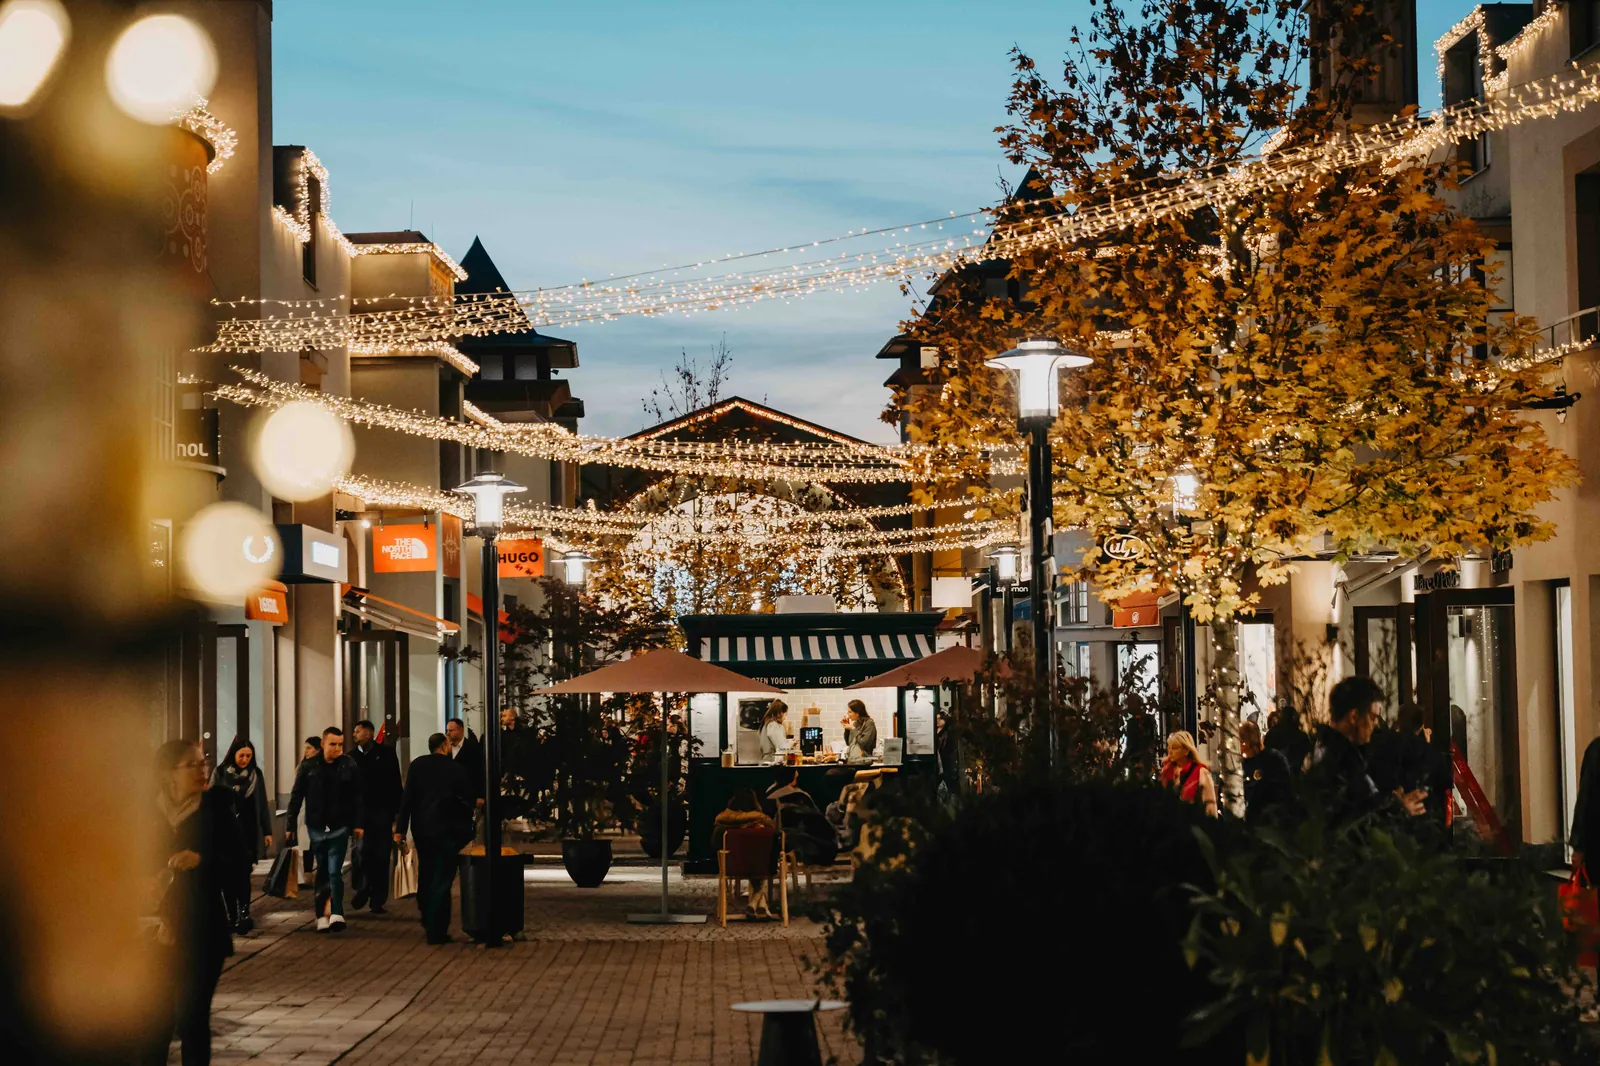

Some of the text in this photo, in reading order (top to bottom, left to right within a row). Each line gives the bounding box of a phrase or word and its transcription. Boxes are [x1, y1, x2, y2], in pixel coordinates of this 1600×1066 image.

[394, 537, 412, 546] THE
[381, 545, 412, 553] NORTH
[390, 552, 412, 560] FACE
[498, 551, 539, 564] HUGO
[771, 676, 797, 685] YOGURT
[818, 676, 842, 685] COFFEE
